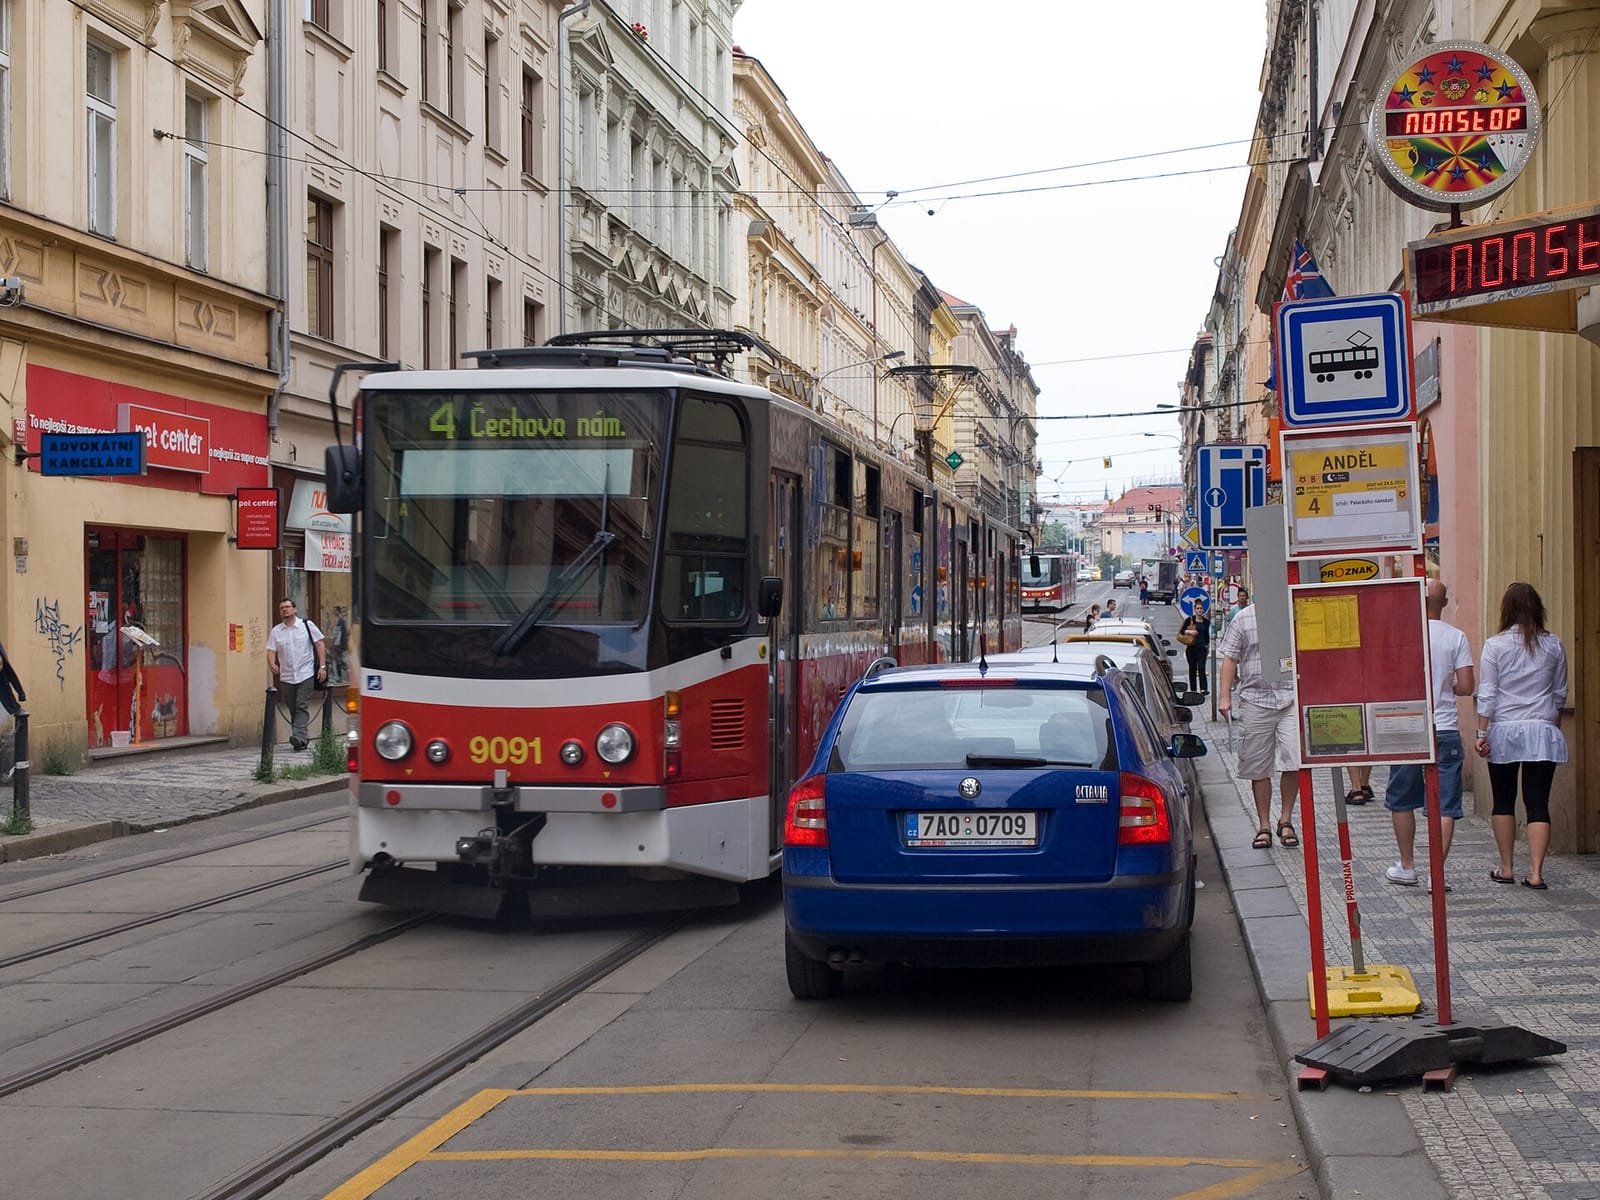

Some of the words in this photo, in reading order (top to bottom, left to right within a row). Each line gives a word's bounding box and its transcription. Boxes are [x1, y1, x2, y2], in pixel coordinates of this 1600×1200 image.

[29, 413, 39, 428] To
[429, 401, 456, 439] 4
[576, 409, 626, 437] nám.
[49, 438, 133, 452] ADVOKÁTNÍ
[160, 428, 203, 455] center
[48, 455, 133, 468] KANCELÁŘE
[1322, 450, 1378, 471] ANDĚL
[238, 499, 251, 508] pet
[251, 499, 278, 508] center
[1308, 497, 1321, 515] 4
[1320, 564, 1374, 579] PROZNAK
[469, 735, 542, 765] 9091
[1075, 785, 1108, 799] OCTAVIA
[907, 829, 918, 837] CZ
[976, 815, 1027, 836] 0709
[1342, 861, 1356, 901] PROZNAK
